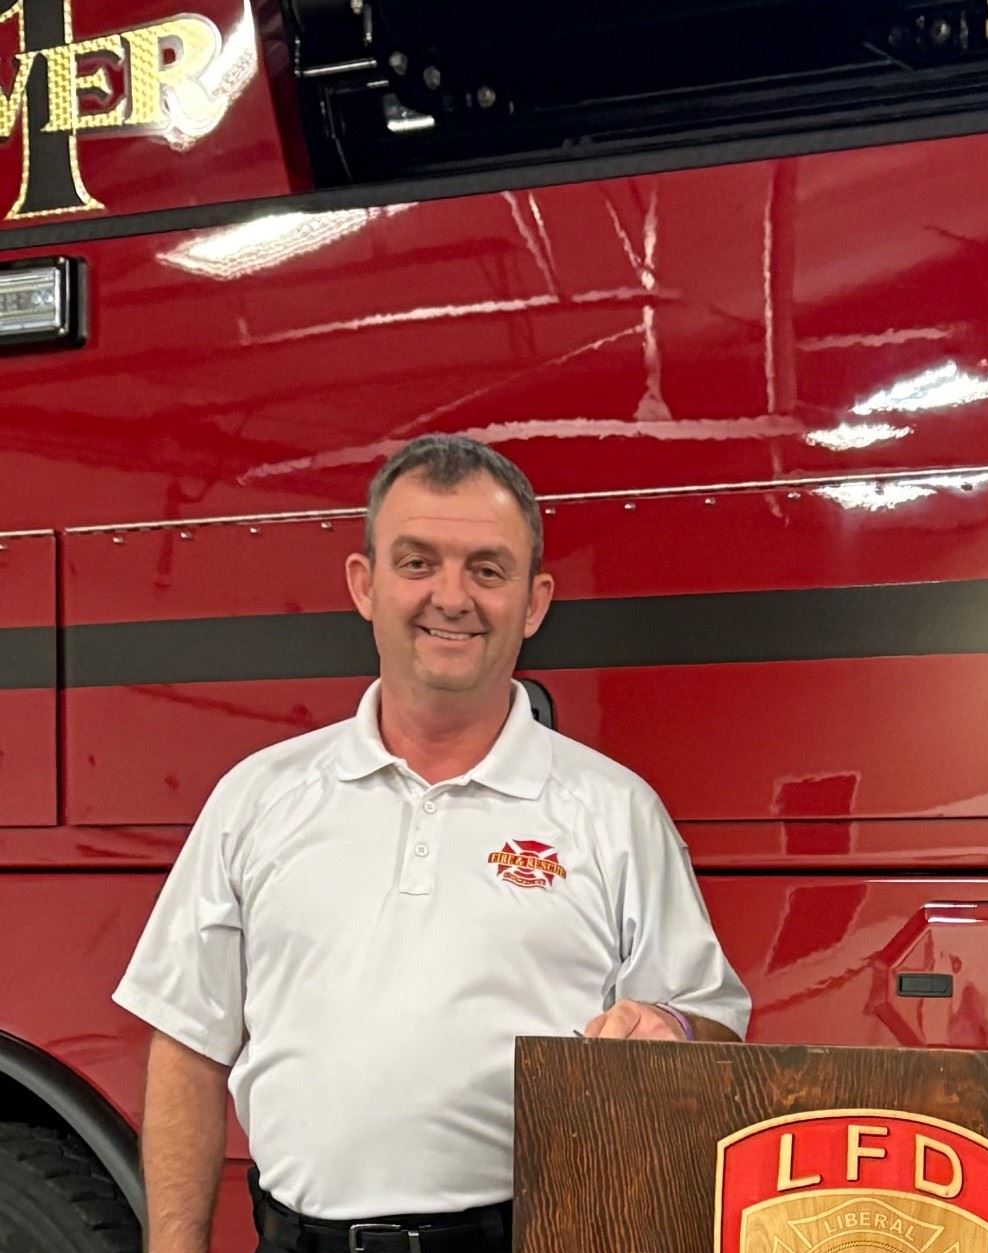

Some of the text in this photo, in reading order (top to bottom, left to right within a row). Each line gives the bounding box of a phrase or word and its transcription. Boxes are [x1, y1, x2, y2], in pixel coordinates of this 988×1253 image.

[491, 852, 514, 865] FIRE
[526, 857, 566, 879] RESCUE
[777, 1124, 963, 1198] LFD
[823, 1211, 915, 1242] LIBERAL
